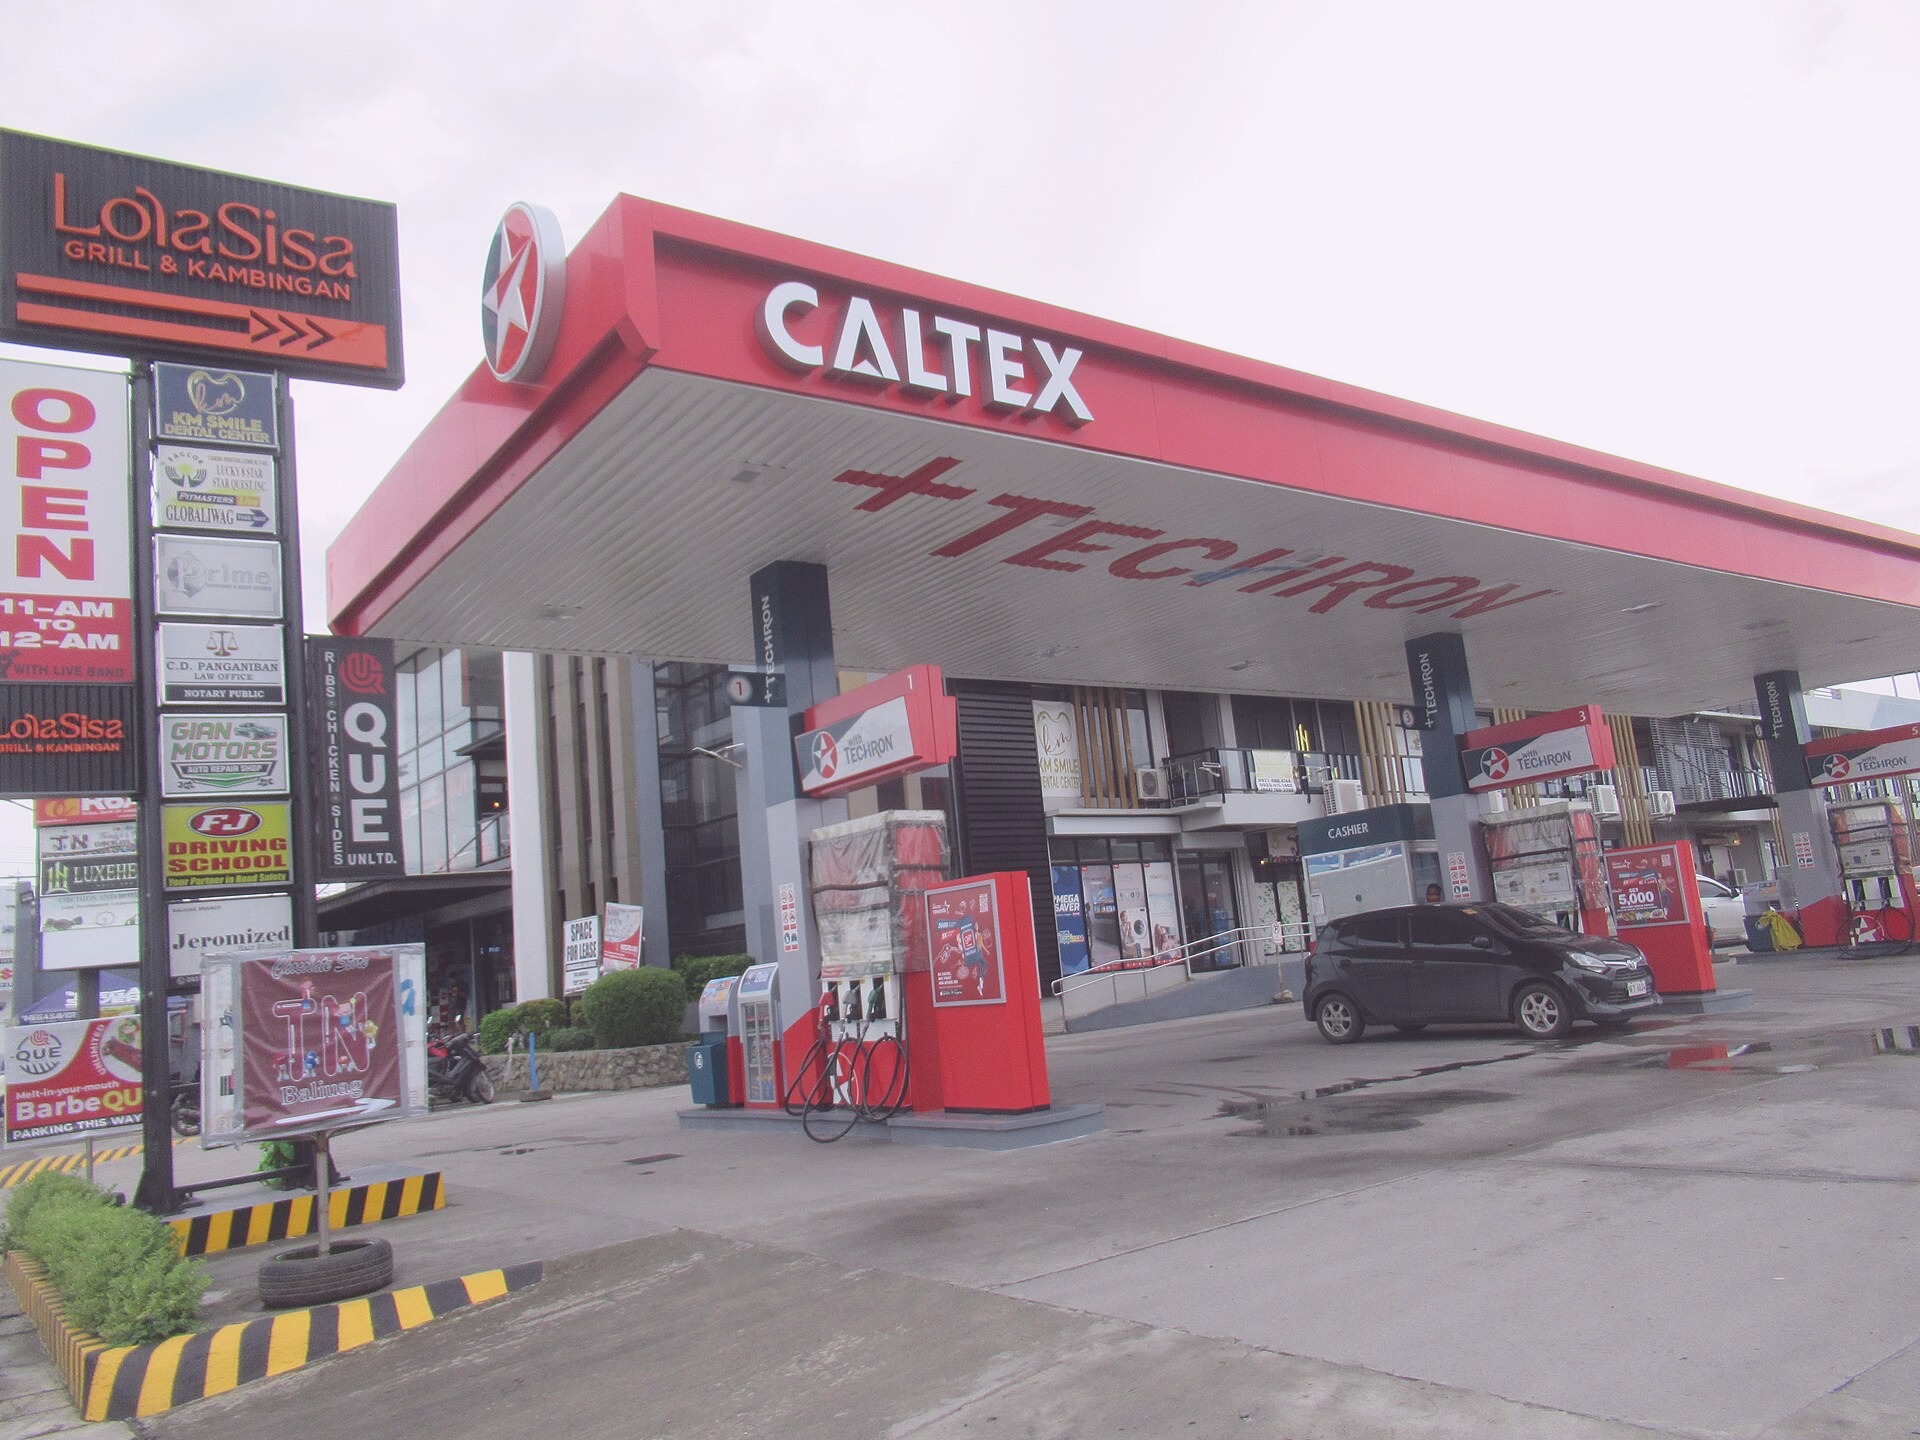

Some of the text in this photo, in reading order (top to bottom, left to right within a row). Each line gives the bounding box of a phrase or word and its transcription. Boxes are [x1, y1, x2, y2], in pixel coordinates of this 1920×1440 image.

[64, 239, 353, 301] GRILL & KAMBINGAN
[757, 281, 1095, 423] CALTEX
[172, 411, 263, 432] KM SMILE
[164, 423, 271, 443] DENTAL CENTER
[11, 387, 97, 581] OPEN
[179, 492, 235, 505] PITMASTERS
[165, 504, 234, 525] GLOBALIWAG
[0, 598, 114, 618] 11-AM
[33, 618, 76, 631] TO
[14, 663, 125, 679] WITH LIVE BAND
[166, 661, 279, 672] C.D. PANGANIBAN
[324, 650, 336, 698] RIBS
[194, 673, 254, 681] LAW OFFICE
[906, 673, 913, 690] 1
[184, 689, 265, 699] NOTARY PUBLIC
[1578, 710, 1587, 723] 3
[170, 722, 233, 741] GIAN
[849, 733, 863, 746] with
[1911, 726, 1918, 736] 5
[35, 743, 44, 753] &
[46, 743, 120, 753] KAMBINGAN
[170, 741, 279, 761] MOTORS
[326, 710, 341, 793] CHICKEN
[843, 734, 894, 765] TECHRON
[1521, 749, 1538, 759] with
[187, 764, 263, 774] AUTO REPAIR SHOP
[1053, 757, 1079, 774] SMILE
[1516, 750, 1572, 771] TECHRON
[1857, 756, 1907, 772] TECHRON
[343, 701, 391, 843] QUE
[1042, 776, 1060, 789] ENTAL
[197, 813, 254, 831] FJ
[1327, 822, 1369, 839] CASHIER
[331, 804, 344, 866] SIDES
[168, 838, 287, 856] DRIVING
[168, 854, 287, 873] SCHOOL
[347, 852, 397, 866] UNLTD.
[1054, 903, 1080, 912] SAVER
[1056, 894, 1080, 904] MEGA
[1618, 892, 1655, 906] 5,000
[172, 925, 290, 950] Jeromized
[571, 920, 593, 942] SPACE
[566, 944, 579, 961] FOR
[579, 941, 597, 960] LEASE
[271, 953, 370, 979] Chocolate Store
[272, 992, 370, 1082] TN
[16, 1047, 62, 1062] QUE
[90, 1024, 107, 1076] UNLIMITED
[16, 1080, 121, 1100] Melt-in-your-mouth
[279, 1079, 365, 1106] Baliuag
[13, 1113, 143, 1141] PARKING THIS WAY
